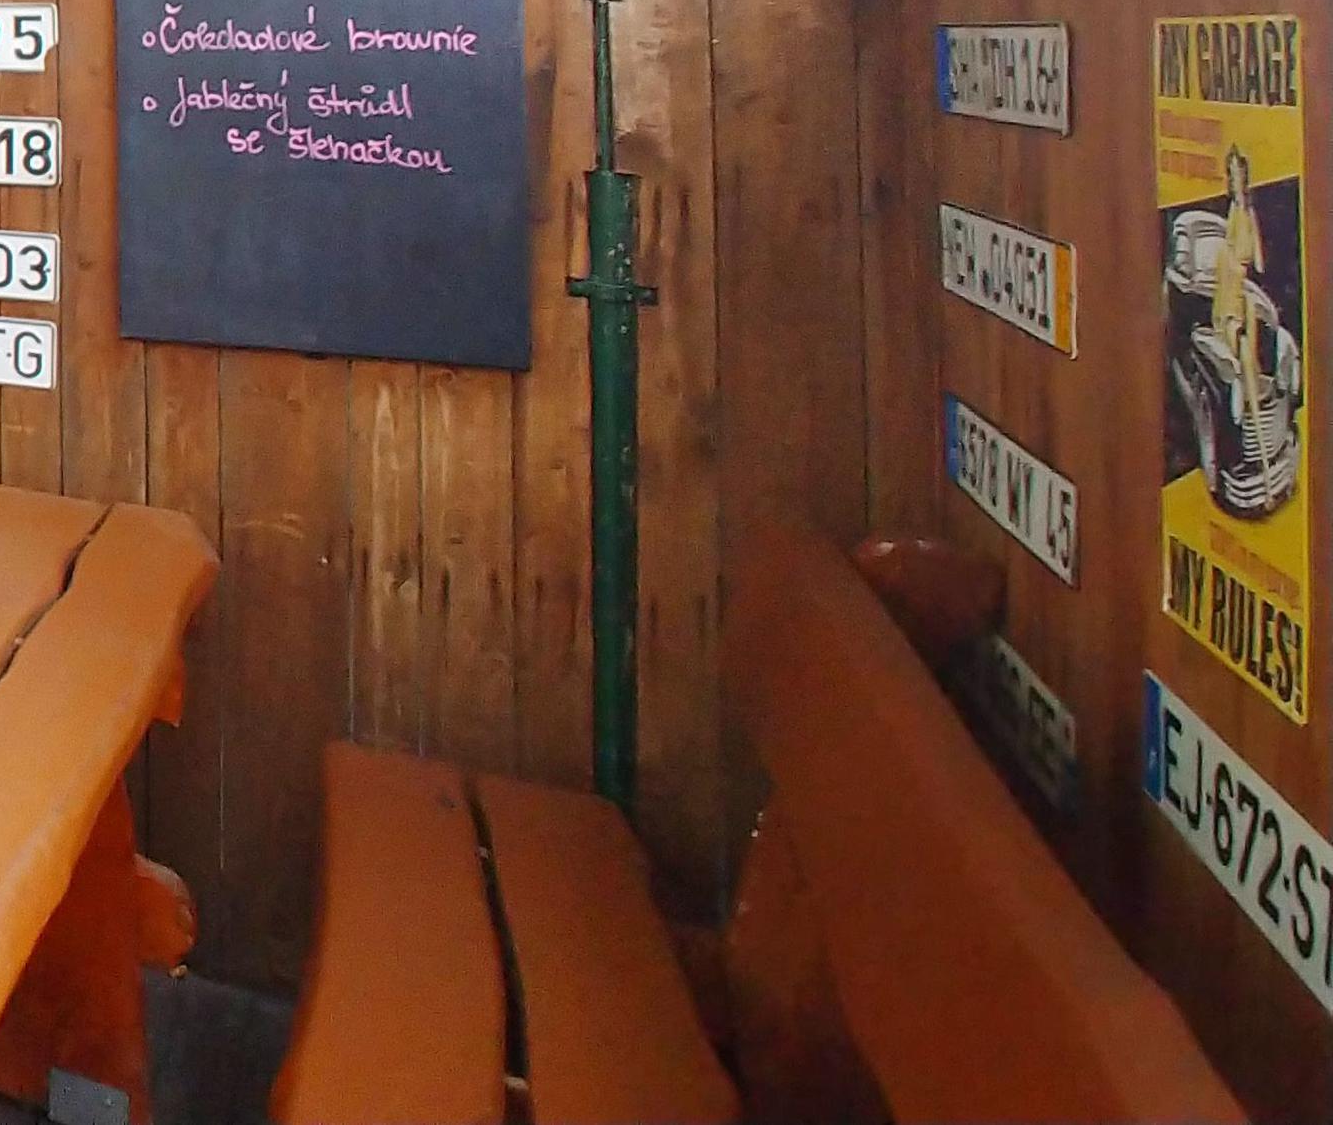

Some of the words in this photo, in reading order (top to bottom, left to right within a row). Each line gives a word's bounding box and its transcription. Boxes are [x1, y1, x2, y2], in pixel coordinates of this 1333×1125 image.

[347, 19, 478, 55] brownie
[1159, 24, 1189, 98] MY
[1197, 21, 1297, 106] GARAGE
[170, 70, 289, 135] Jablečný
[308, 84, 413, 119] štrůdl
[227, 127, 264, 155] se
[288, 127, 453, 173] šlehačkou
[1169, 537, 1205, 630] MY
[1210, 565, 1304, 716] RULES!
